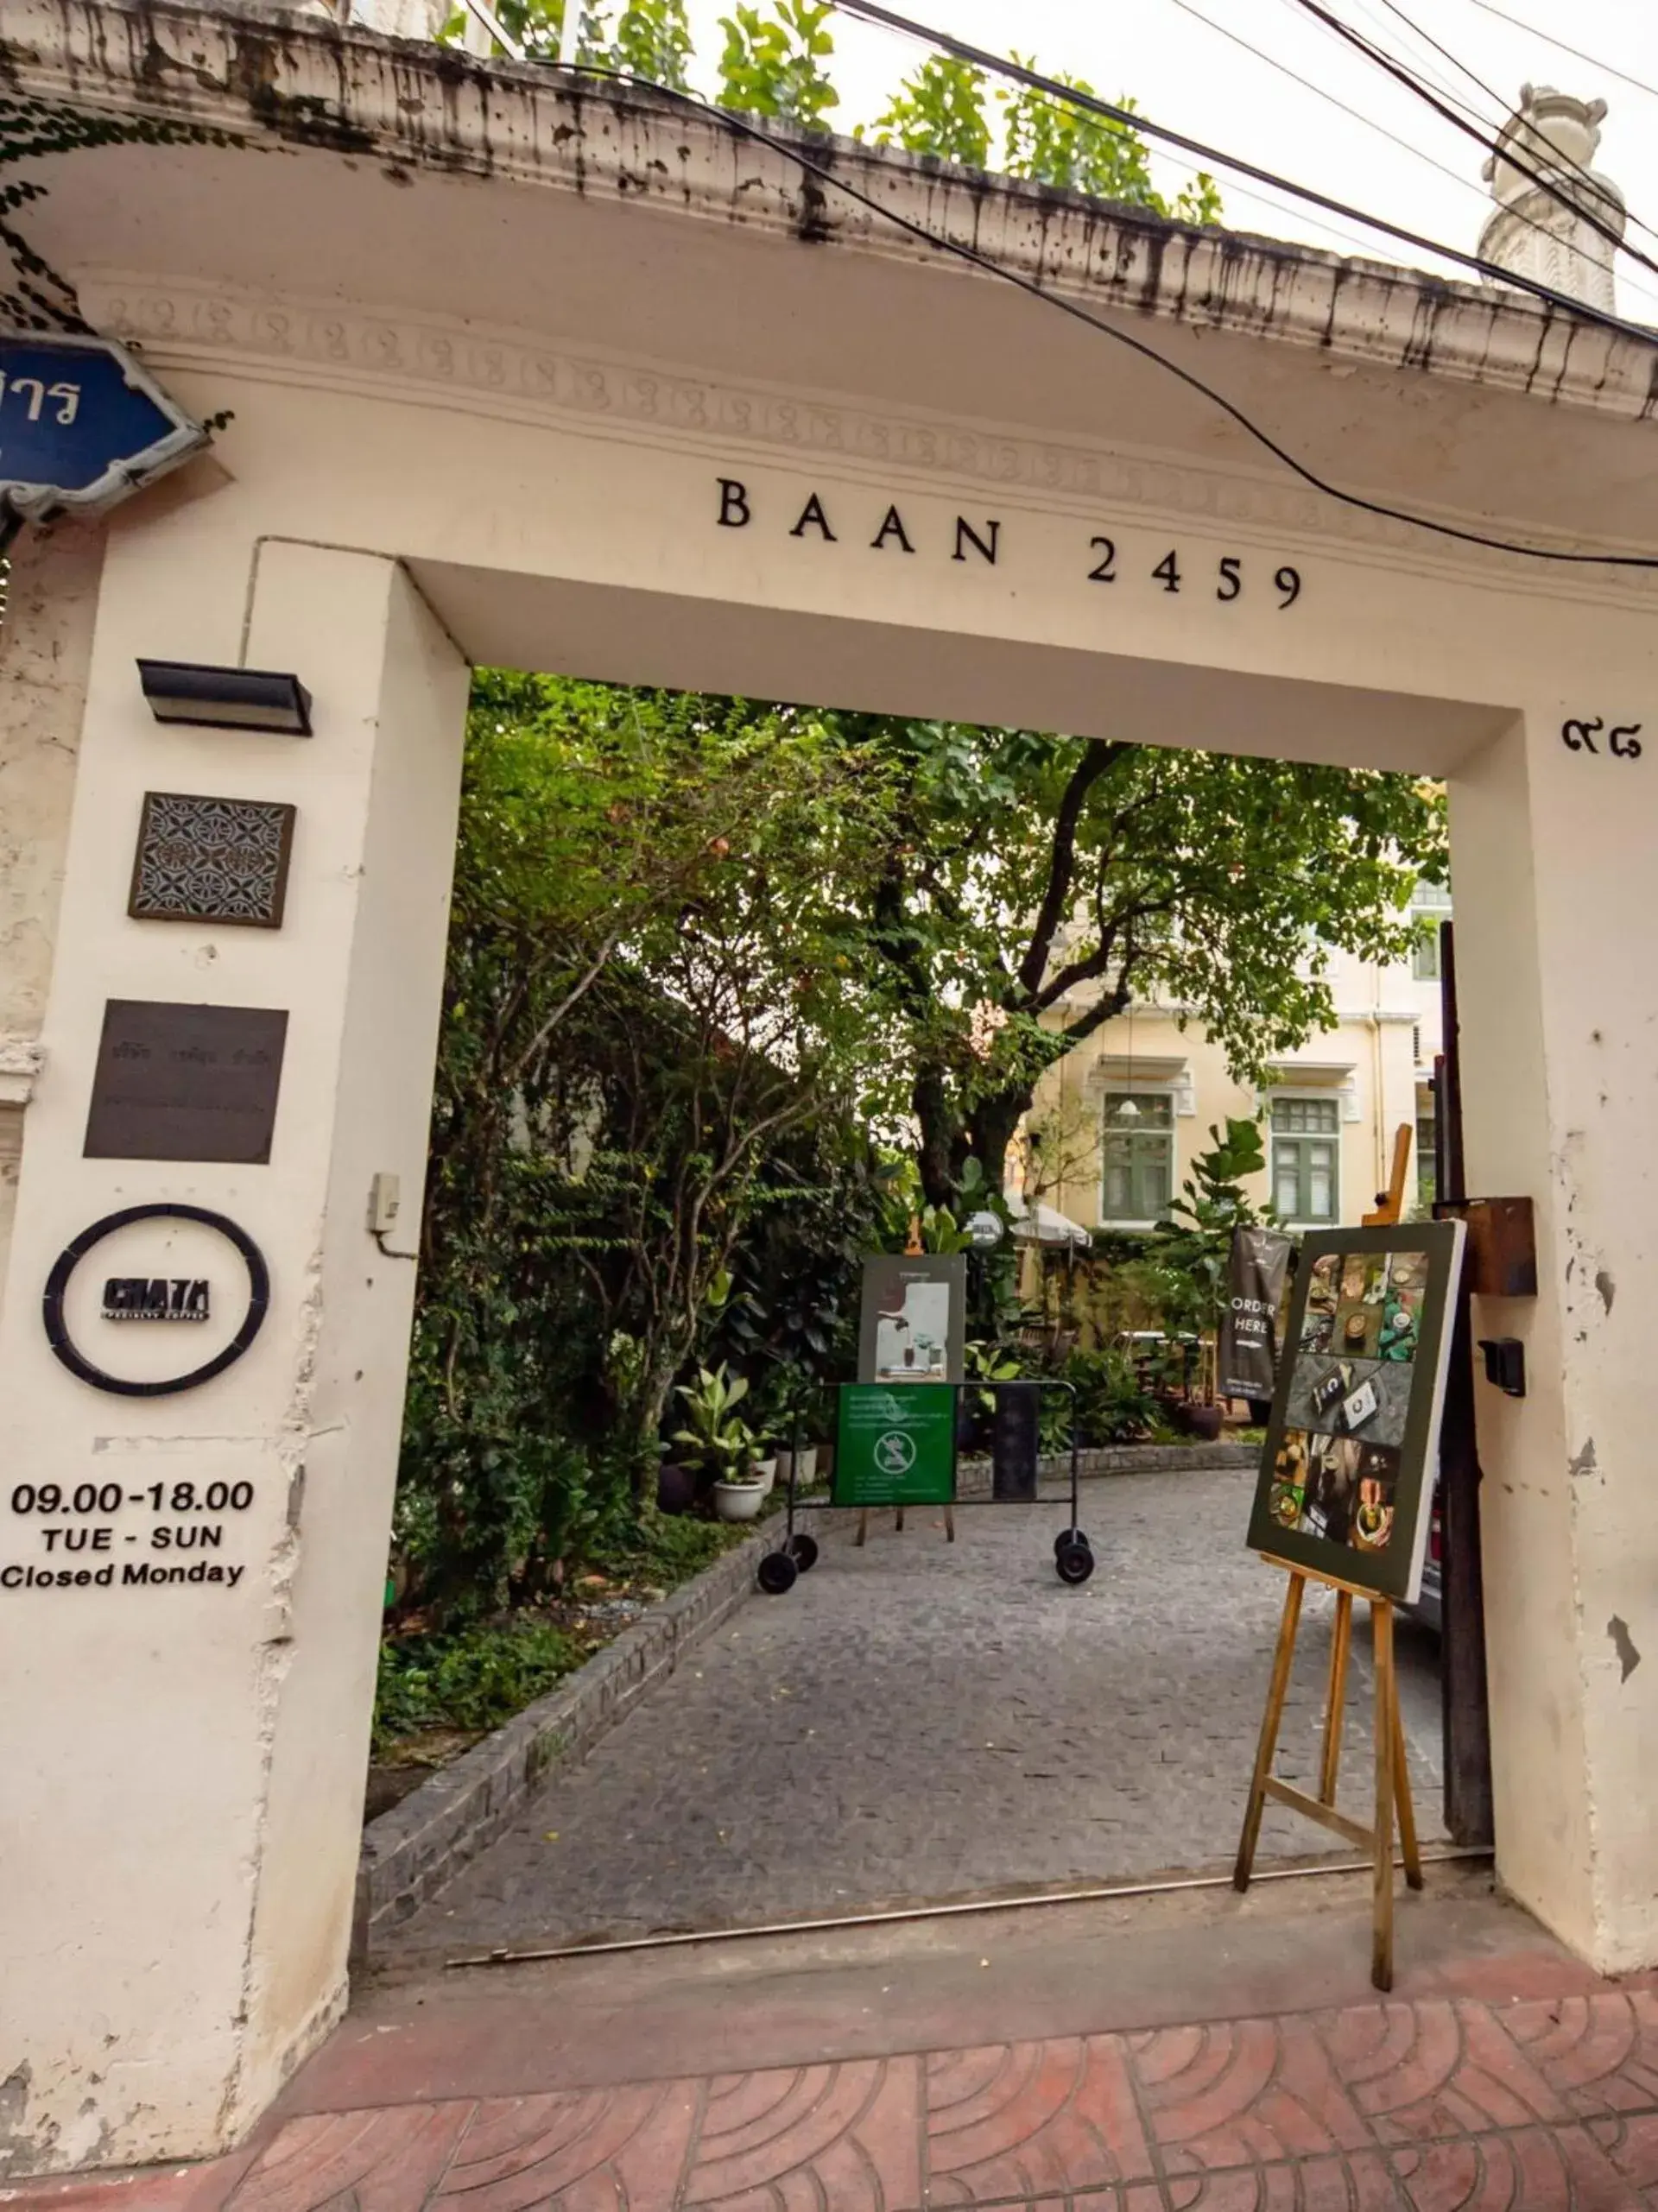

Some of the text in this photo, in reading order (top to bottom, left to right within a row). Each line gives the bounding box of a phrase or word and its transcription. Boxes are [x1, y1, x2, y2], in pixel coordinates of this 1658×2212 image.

[716, 477, 1300, 610] BAAN 2459
[1561, 716, 1642, 758] ๙๘
[1231, 1298, 1275, 1318] ORDER
[1235, 1318, 1269, 1334] HERE
[11, 1481, 254, 1514] 09.00-18.00
[41, 1527, 113, 1552] TUE
[150, 1526, 222, 1550] SUN
[0, 1561, 244, 1588] Closed Monday
